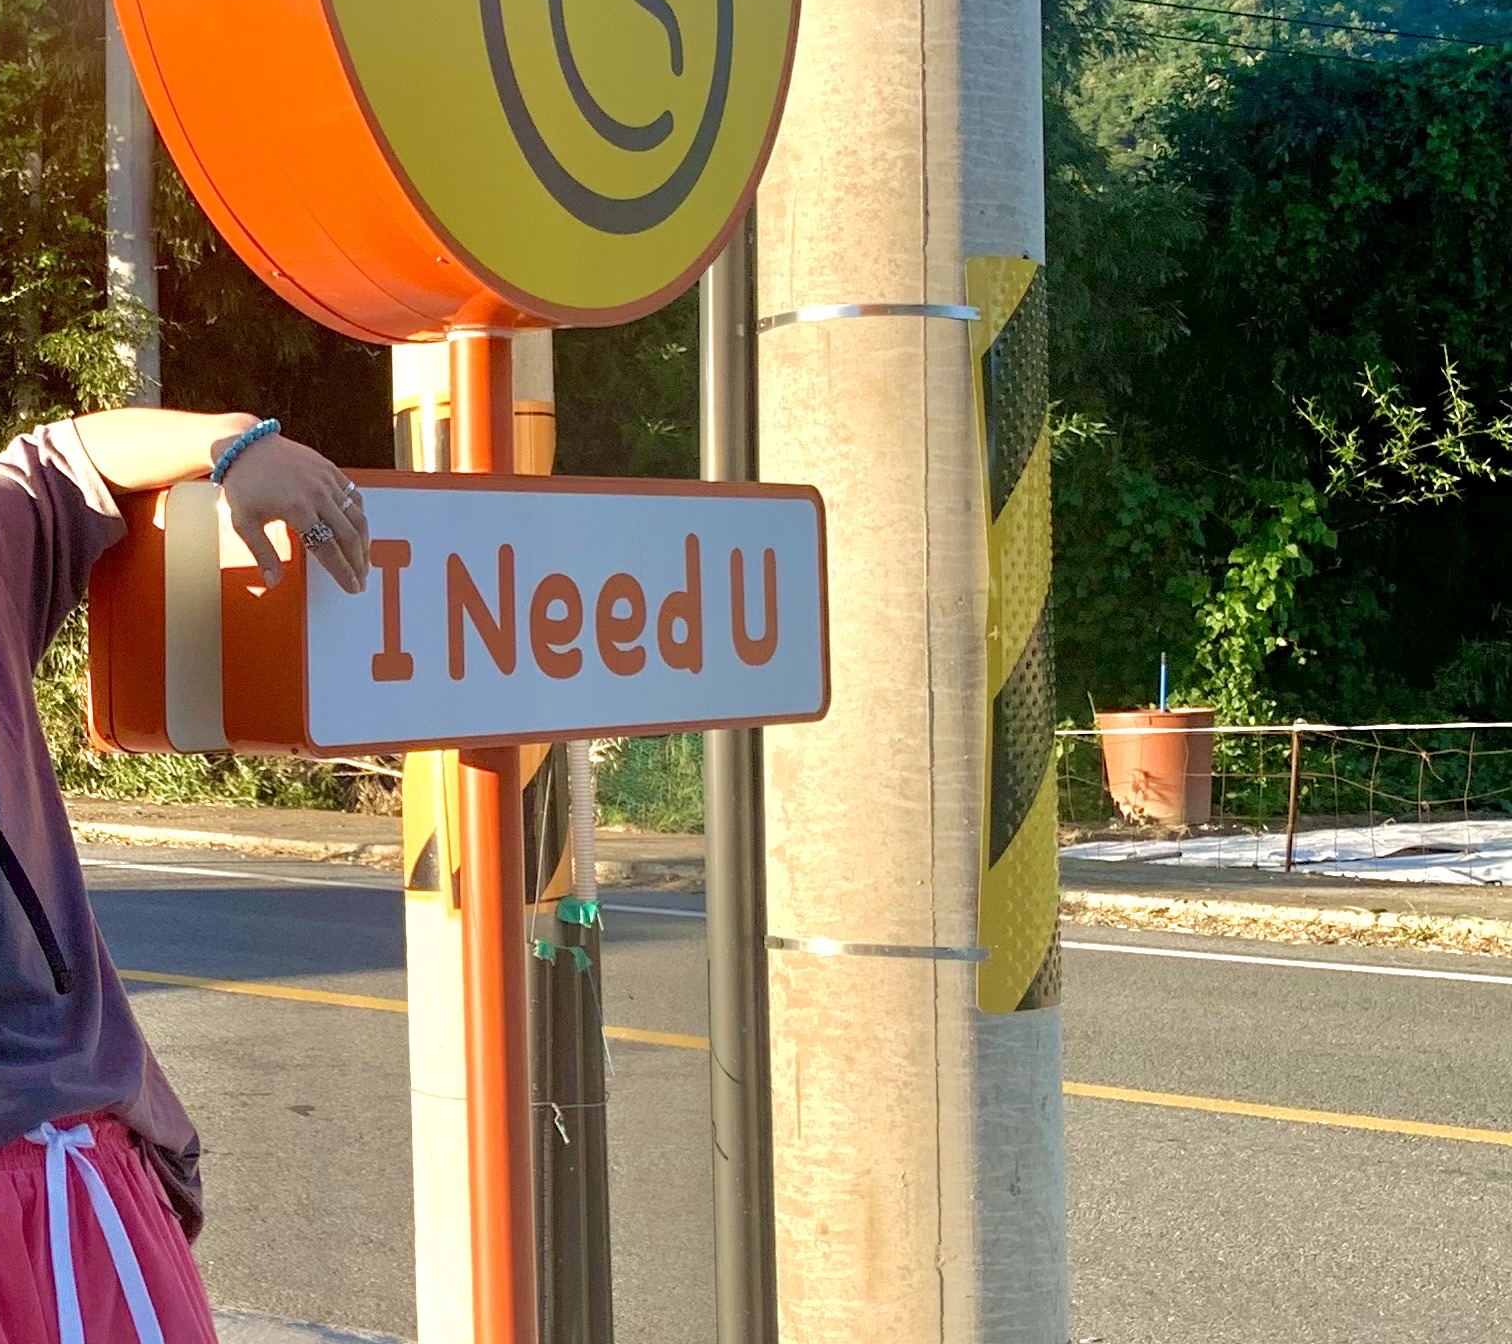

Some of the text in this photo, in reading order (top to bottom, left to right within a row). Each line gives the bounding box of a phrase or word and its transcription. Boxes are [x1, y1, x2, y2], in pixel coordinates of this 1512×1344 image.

[369, 533, 778, 682] I Need U
